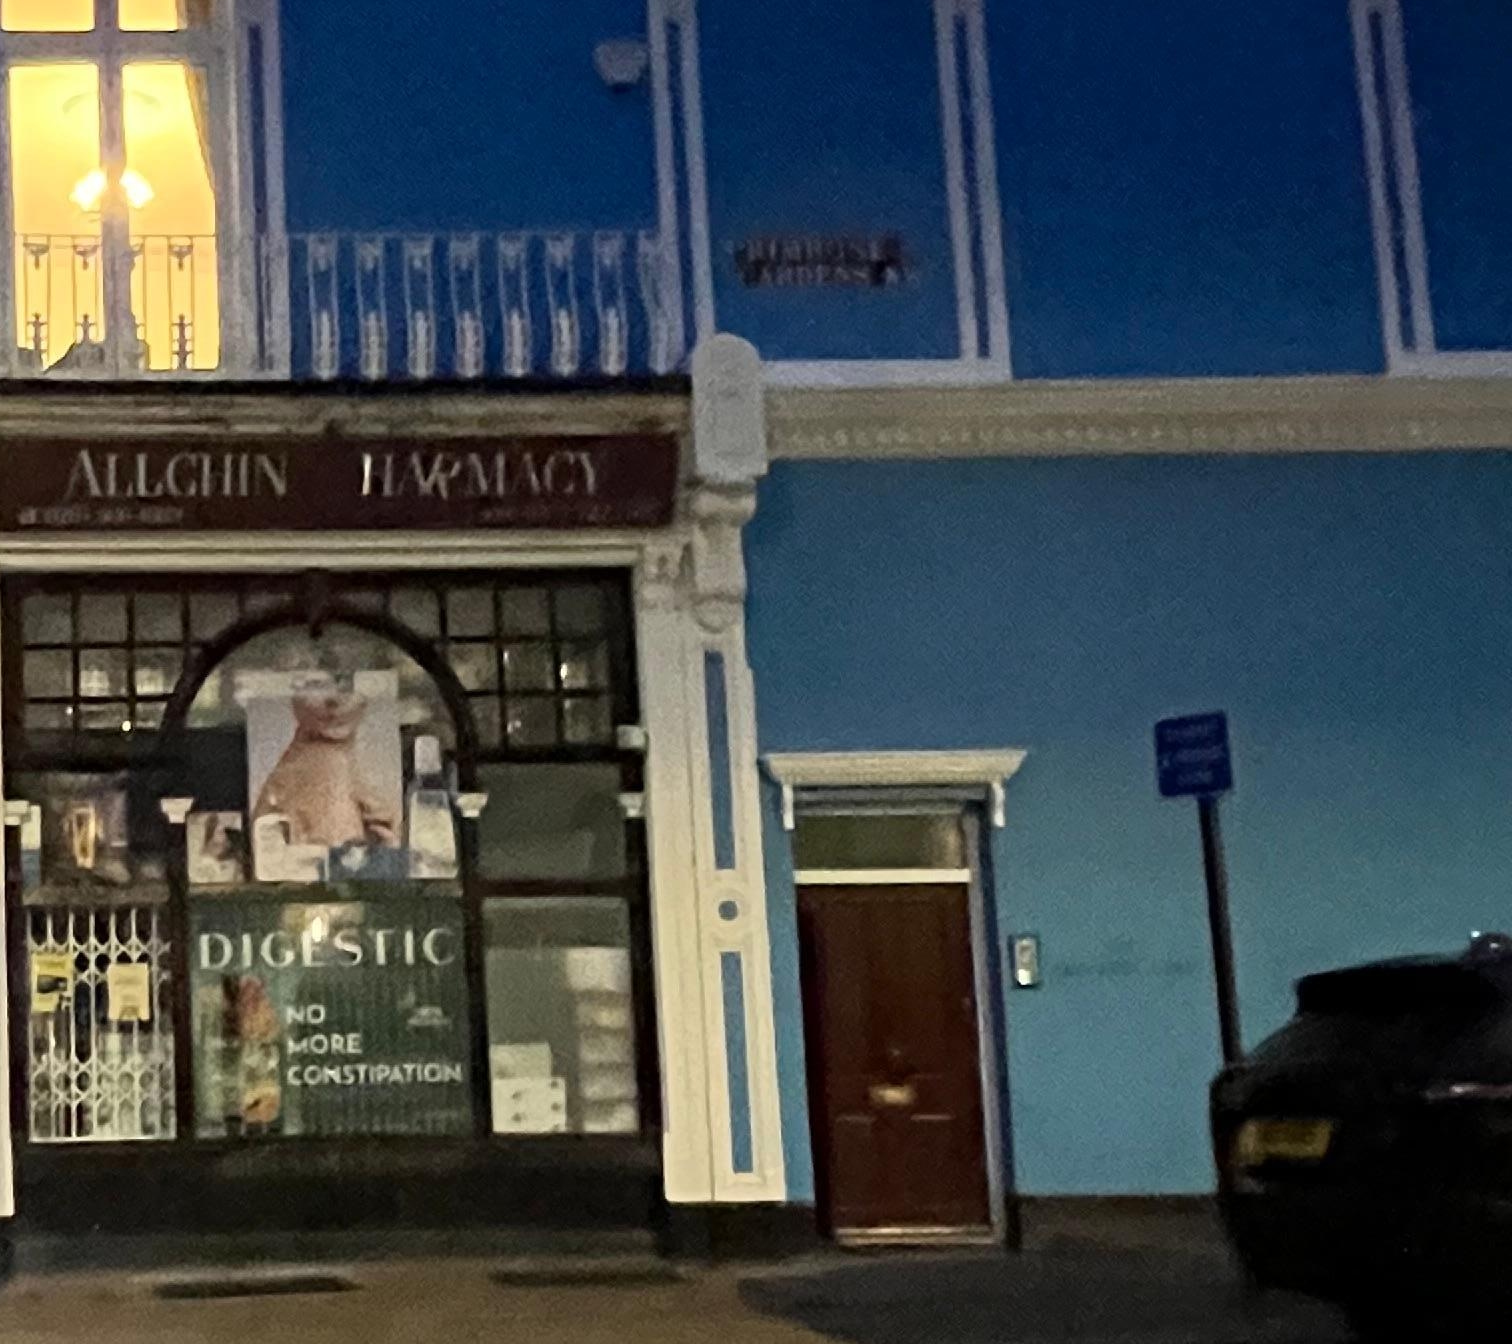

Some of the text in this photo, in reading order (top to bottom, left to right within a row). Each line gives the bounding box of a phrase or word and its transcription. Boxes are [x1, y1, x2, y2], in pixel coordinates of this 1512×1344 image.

[63, 448, 599, 500] ALLCHIN HARMACY
[198, 926, 457, 970] DIGESTIC
[285, 1003, 326, 1025] NO
[286, 1032, 363, 1055] MORE
[286, 1062, 463, 1087] CONSTIPATION
